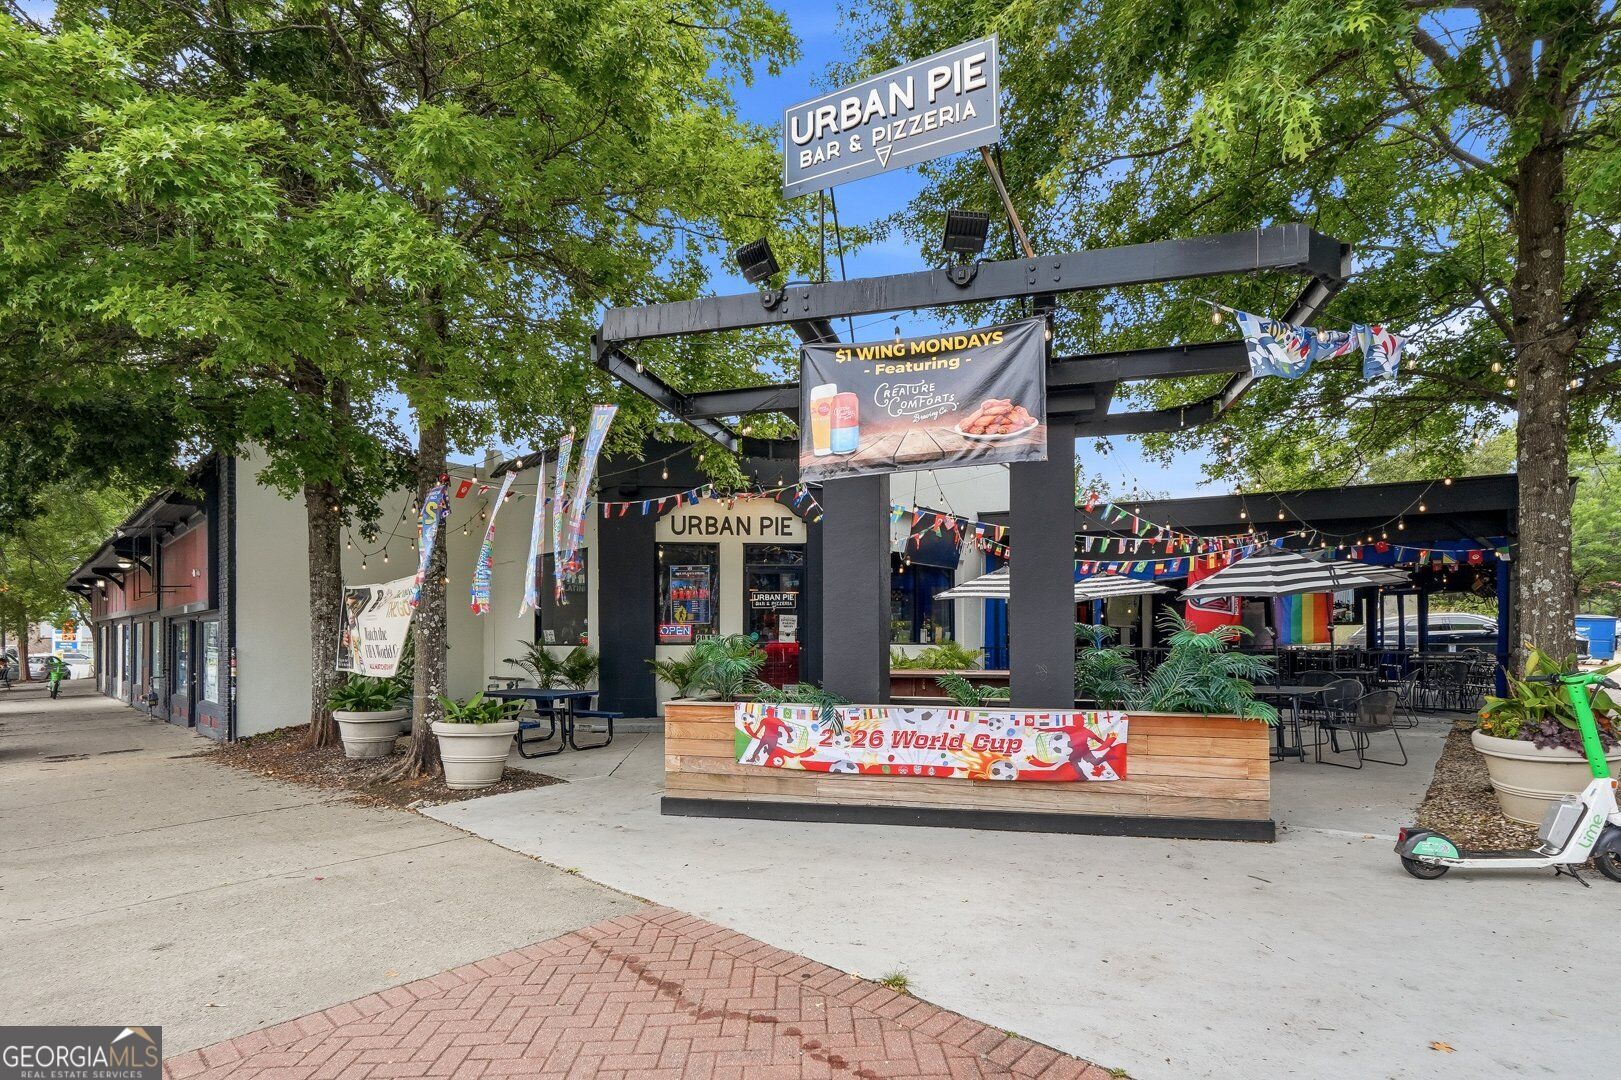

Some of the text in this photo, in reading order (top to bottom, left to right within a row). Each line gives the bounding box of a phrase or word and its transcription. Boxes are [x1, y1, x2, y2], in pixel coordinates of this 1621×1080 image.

[791, 52, 987, 145] URBAN PIE
[799, 99, 977, 169] BAR & PIZZERIA
[835, 331, 1004, 363] $1 WING MONDAYS
[875, 356, 960, 376] Featuring
[874, 379, 936, 407] CREATURE
[888, 393, 956, 417] COMFORTS
[912, 409, 939, 423] Brewing
[670, 515, 793, 536] URBAN PIE
[660, 626, 690, 635] OPEN
[375, 644, 393, 659] World
[891, 730, 965, 751] World
[971, 733, 1023, 756] Cup
[1578, 814, 1603, 848] Lime
